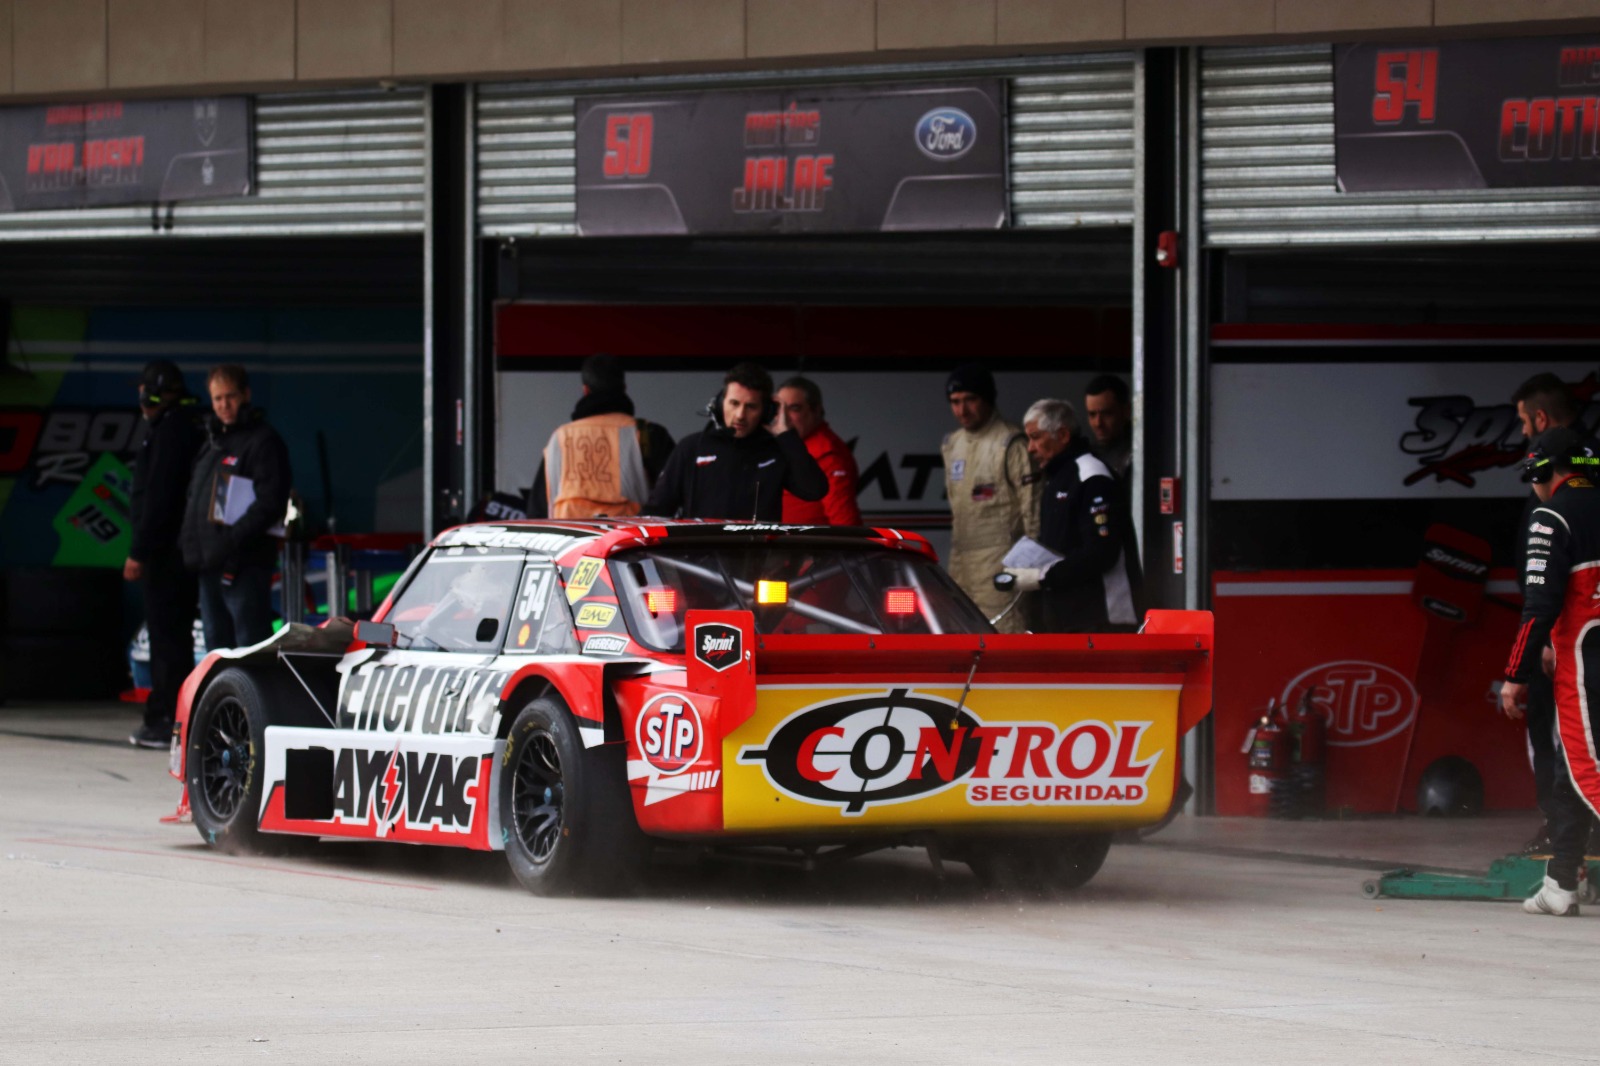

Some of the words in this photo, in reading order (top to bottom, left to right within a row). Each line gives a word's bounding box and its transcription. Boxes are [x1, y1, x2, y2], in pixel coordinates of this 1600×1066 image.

[1372, 49, 1439, 125] 54
[603, 112, 654, 178] 50
[926, 116, 964, 151] Ford
[732, 154, 834, 213] JALAF
[565, 435, 612, 482] 132
[518, 570, 552, 621] 54
[586, 637, 626, 652] EVEREADY
[702, 631, 735, 655] Sprint
[645, 703, 694, 762] STP
[795, 722, 1160, 783] CONTROL
[312, 744, 480, 829] AYOVAC
[970, 784, 1144, 802] SEGURIDAD
